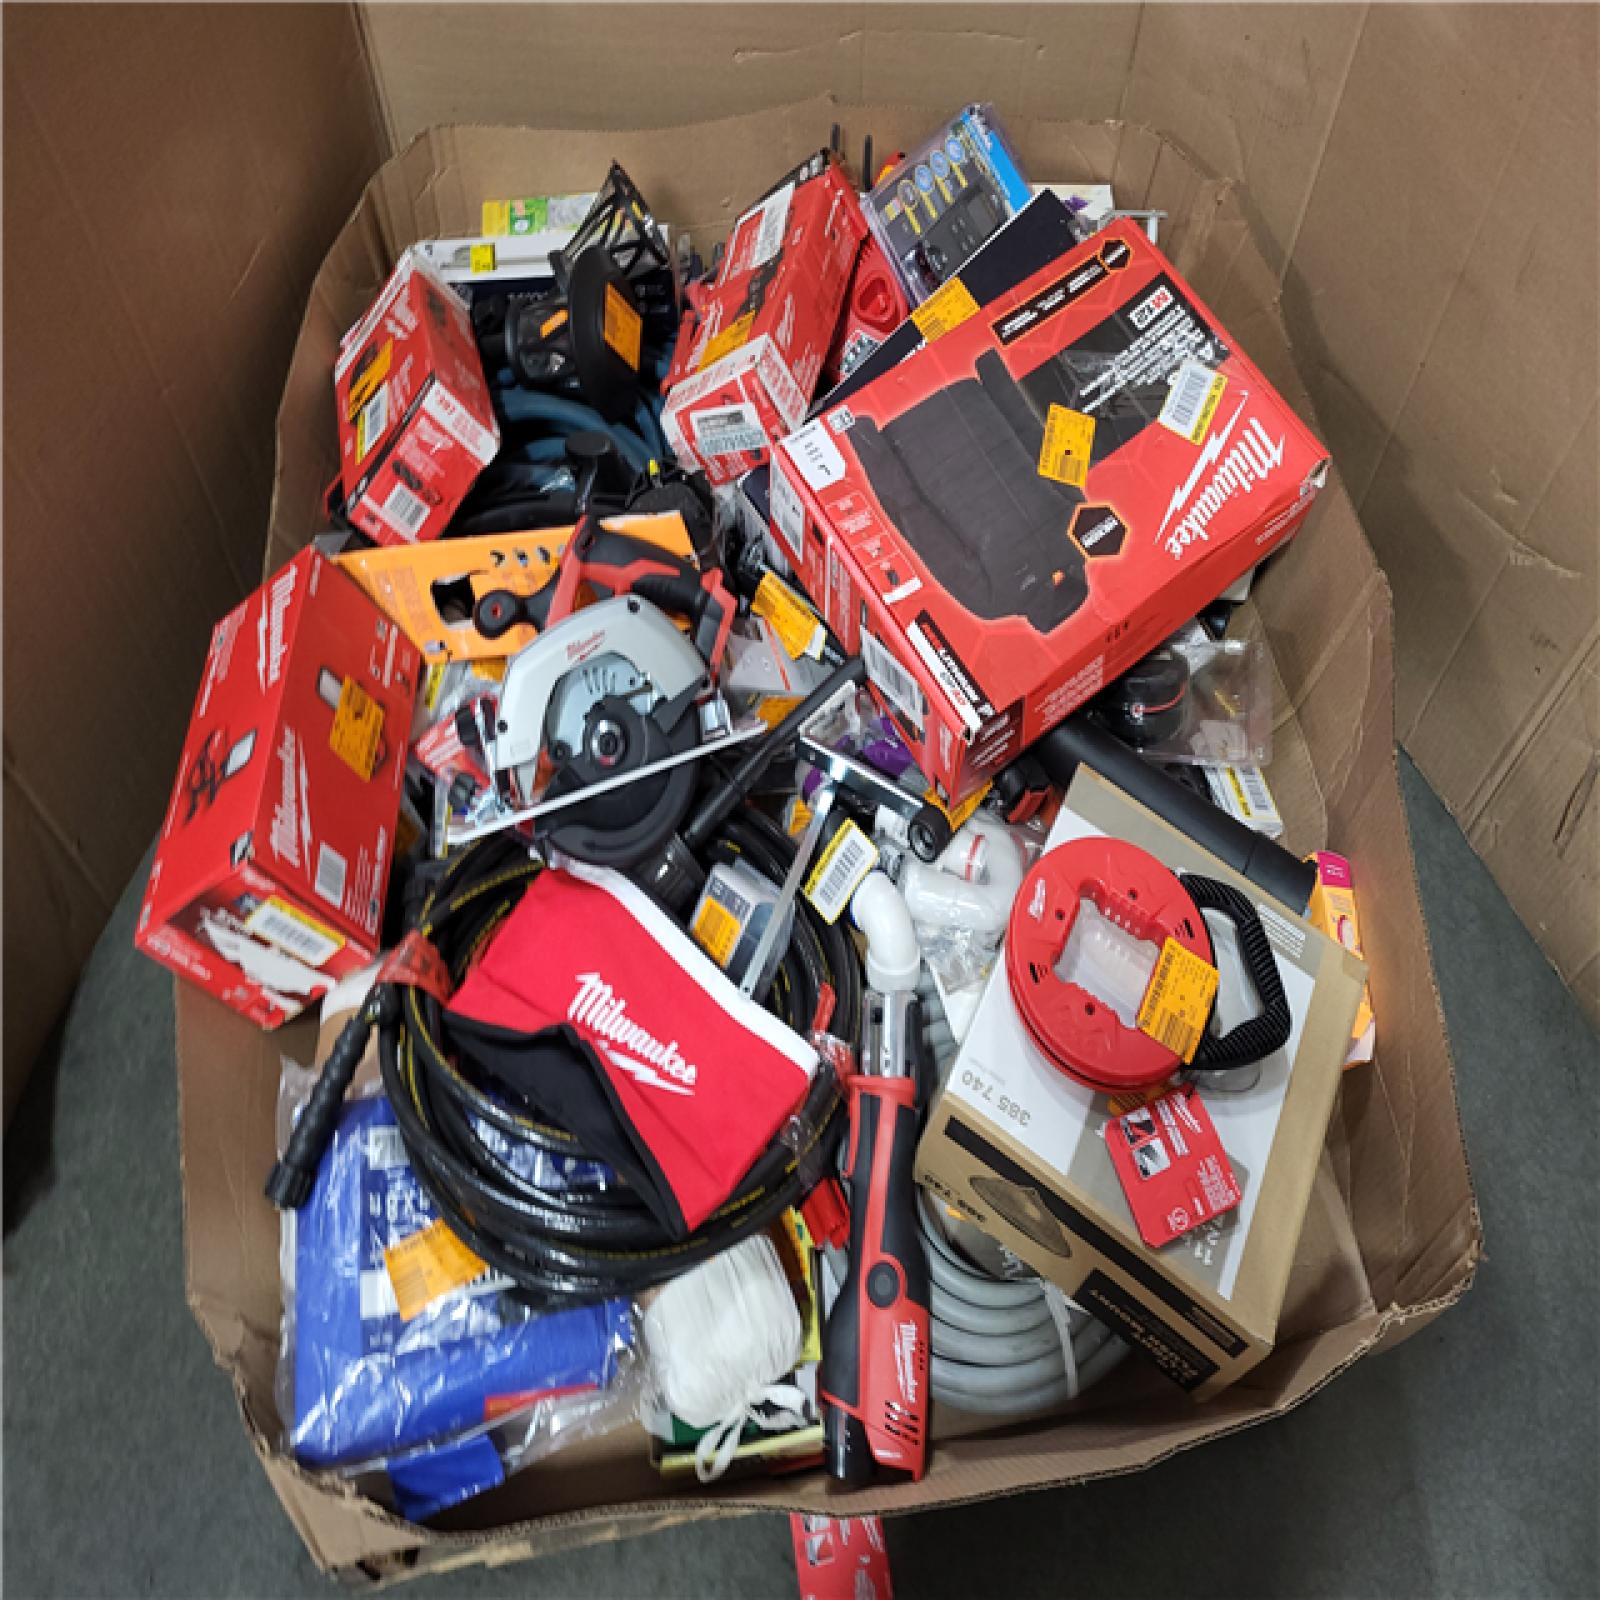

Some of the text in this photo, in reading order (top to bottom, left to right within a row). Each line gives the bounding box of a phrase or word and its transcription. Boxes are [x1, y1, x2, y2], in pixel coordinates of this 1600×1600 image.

[1165, 416, 1284, 561] Milwaukee
[269, 564, 299, 681] Milwaukee
[270, 728, 298, 866] Milwaukee
[567, 971, 698, 1087] Milwaukee
[961, 1070, 1031, 1127] 385 740
[897, 1321, 917, 1402] Milwaukee
